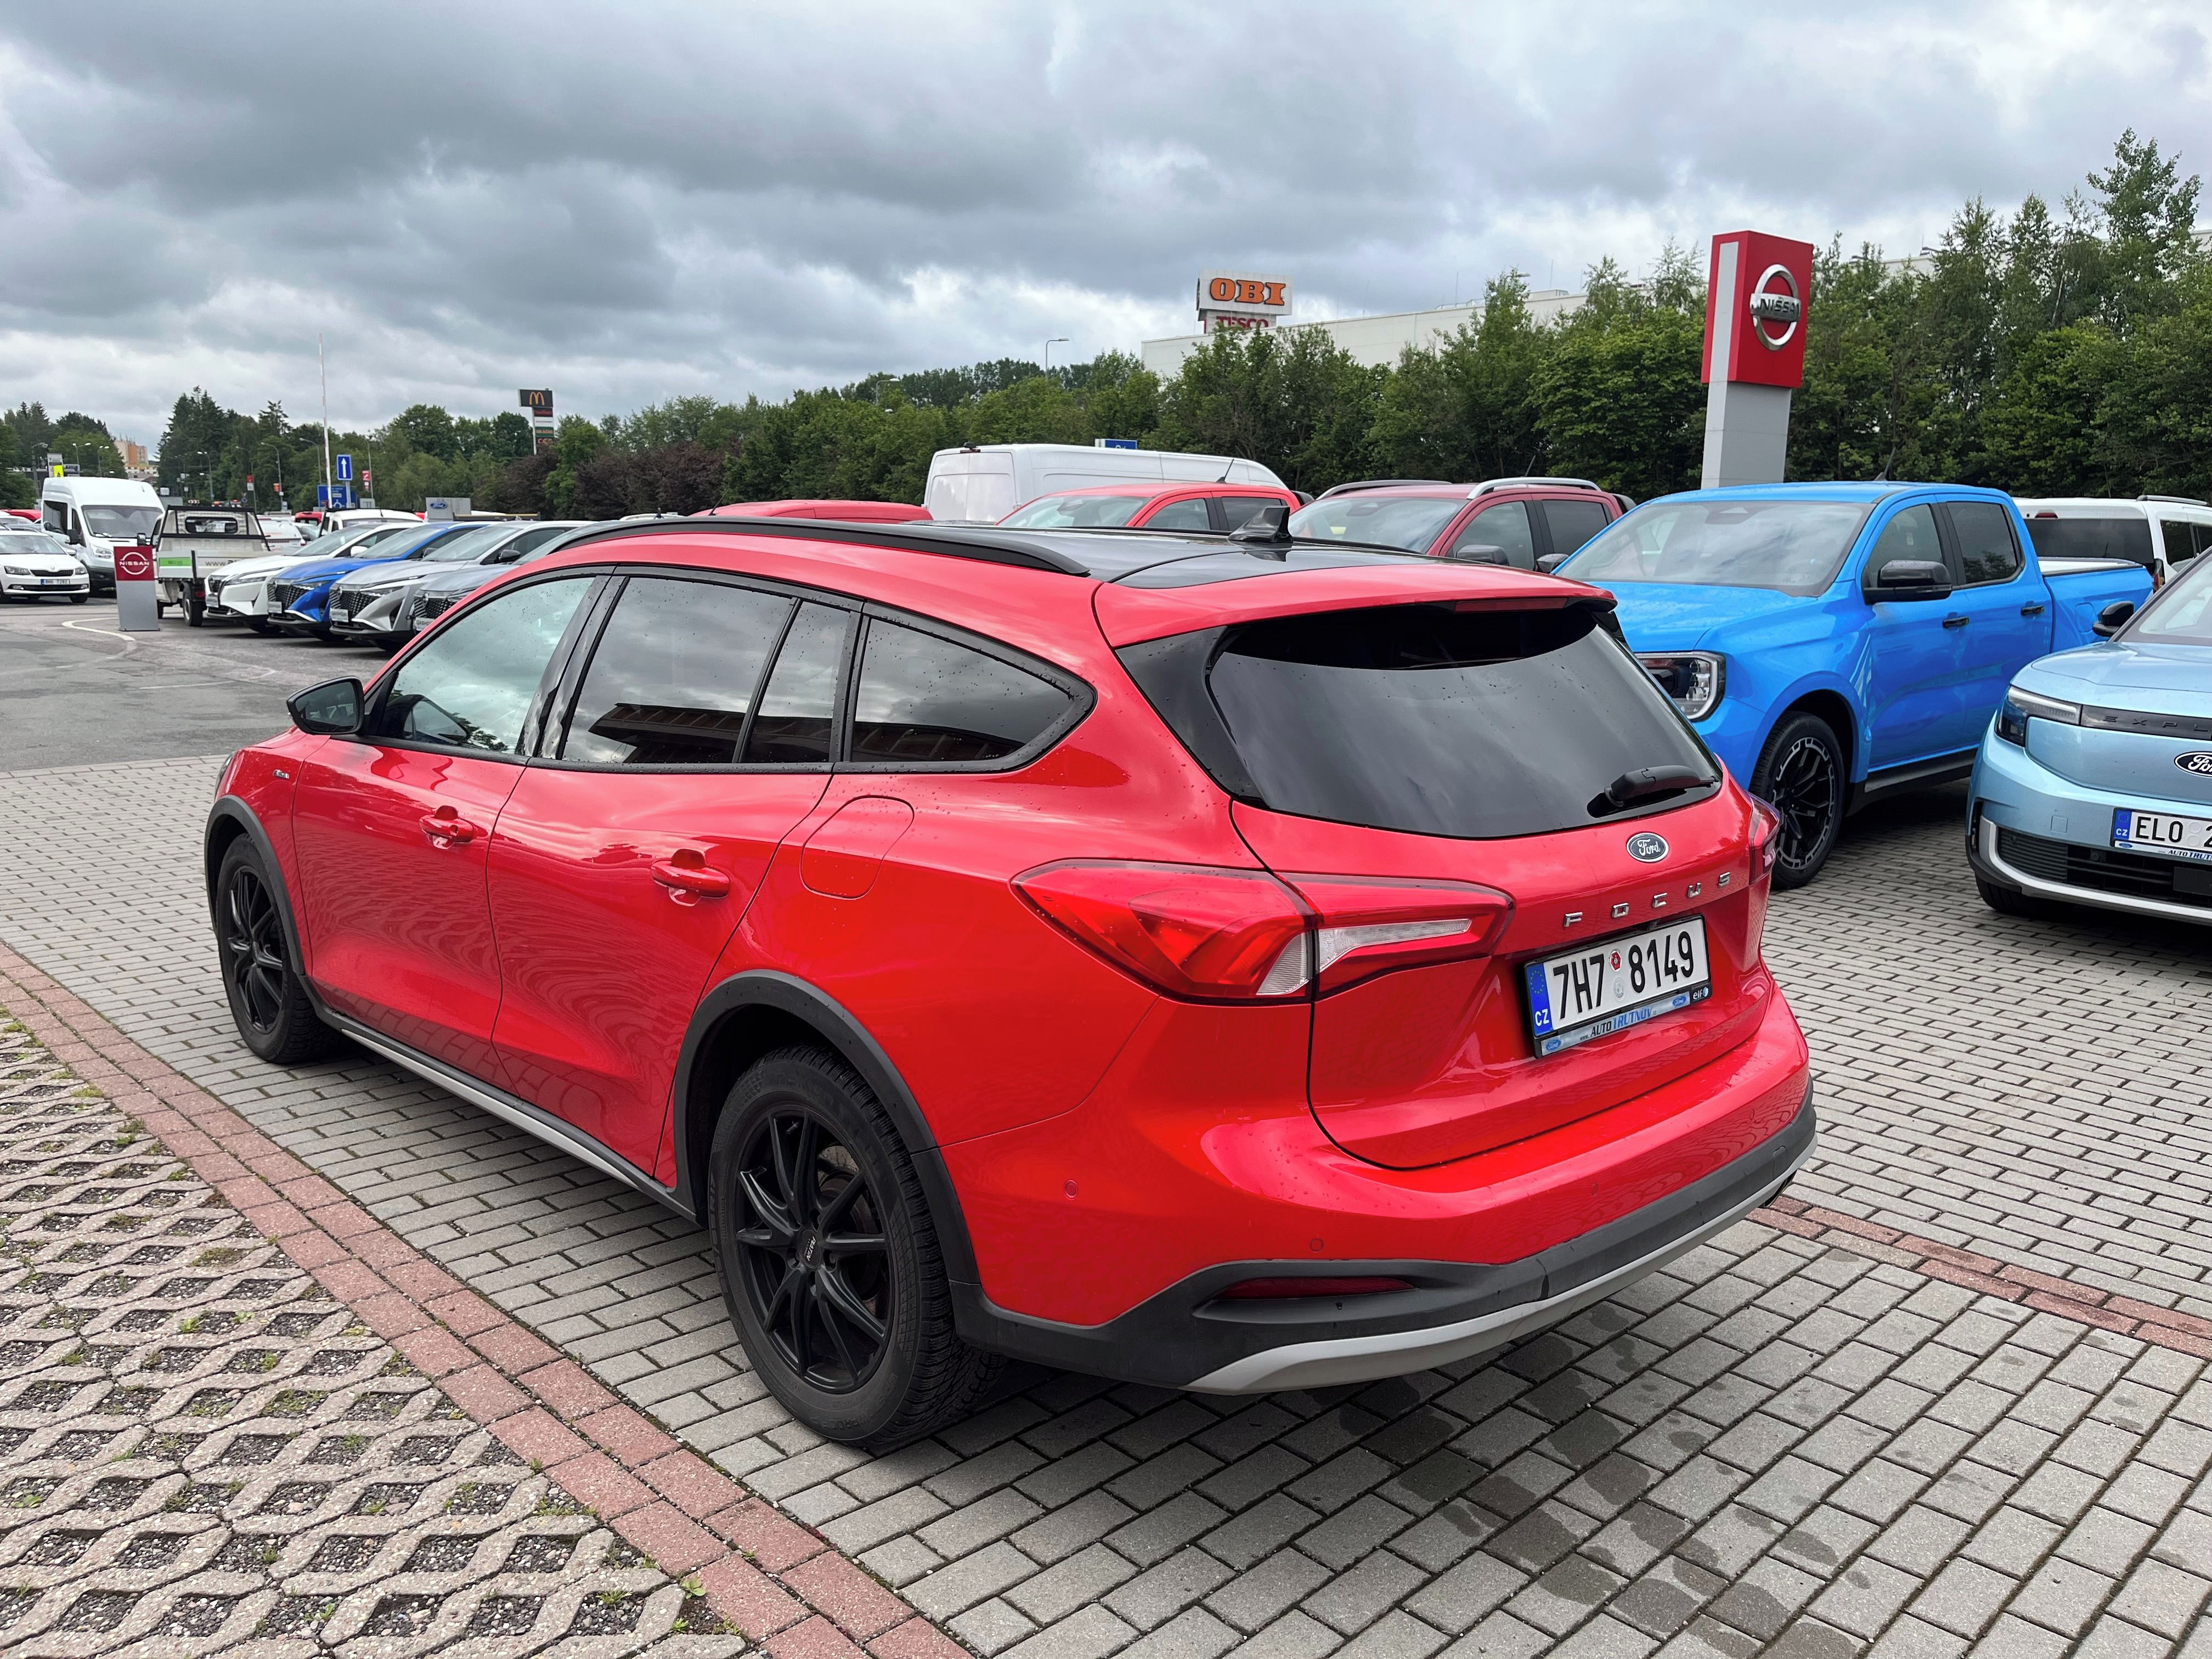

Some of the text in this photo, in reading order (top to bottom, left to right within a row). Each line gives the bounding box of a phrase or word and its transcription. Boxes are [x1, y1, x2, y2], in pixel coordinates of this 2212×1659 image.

[1210, 278, 1286, 306] OBI
[2116, 828, 2128, 837] CZ
[1637, 838, 1661, 856] Ford
[1564, 872, 1730, 927] FOCUS
[1553, 930, 1694, 1019] 7H7 8149
[1692, 991, 1703, 1000] elf
[1535, 1008, 1550, 1026] CZ
